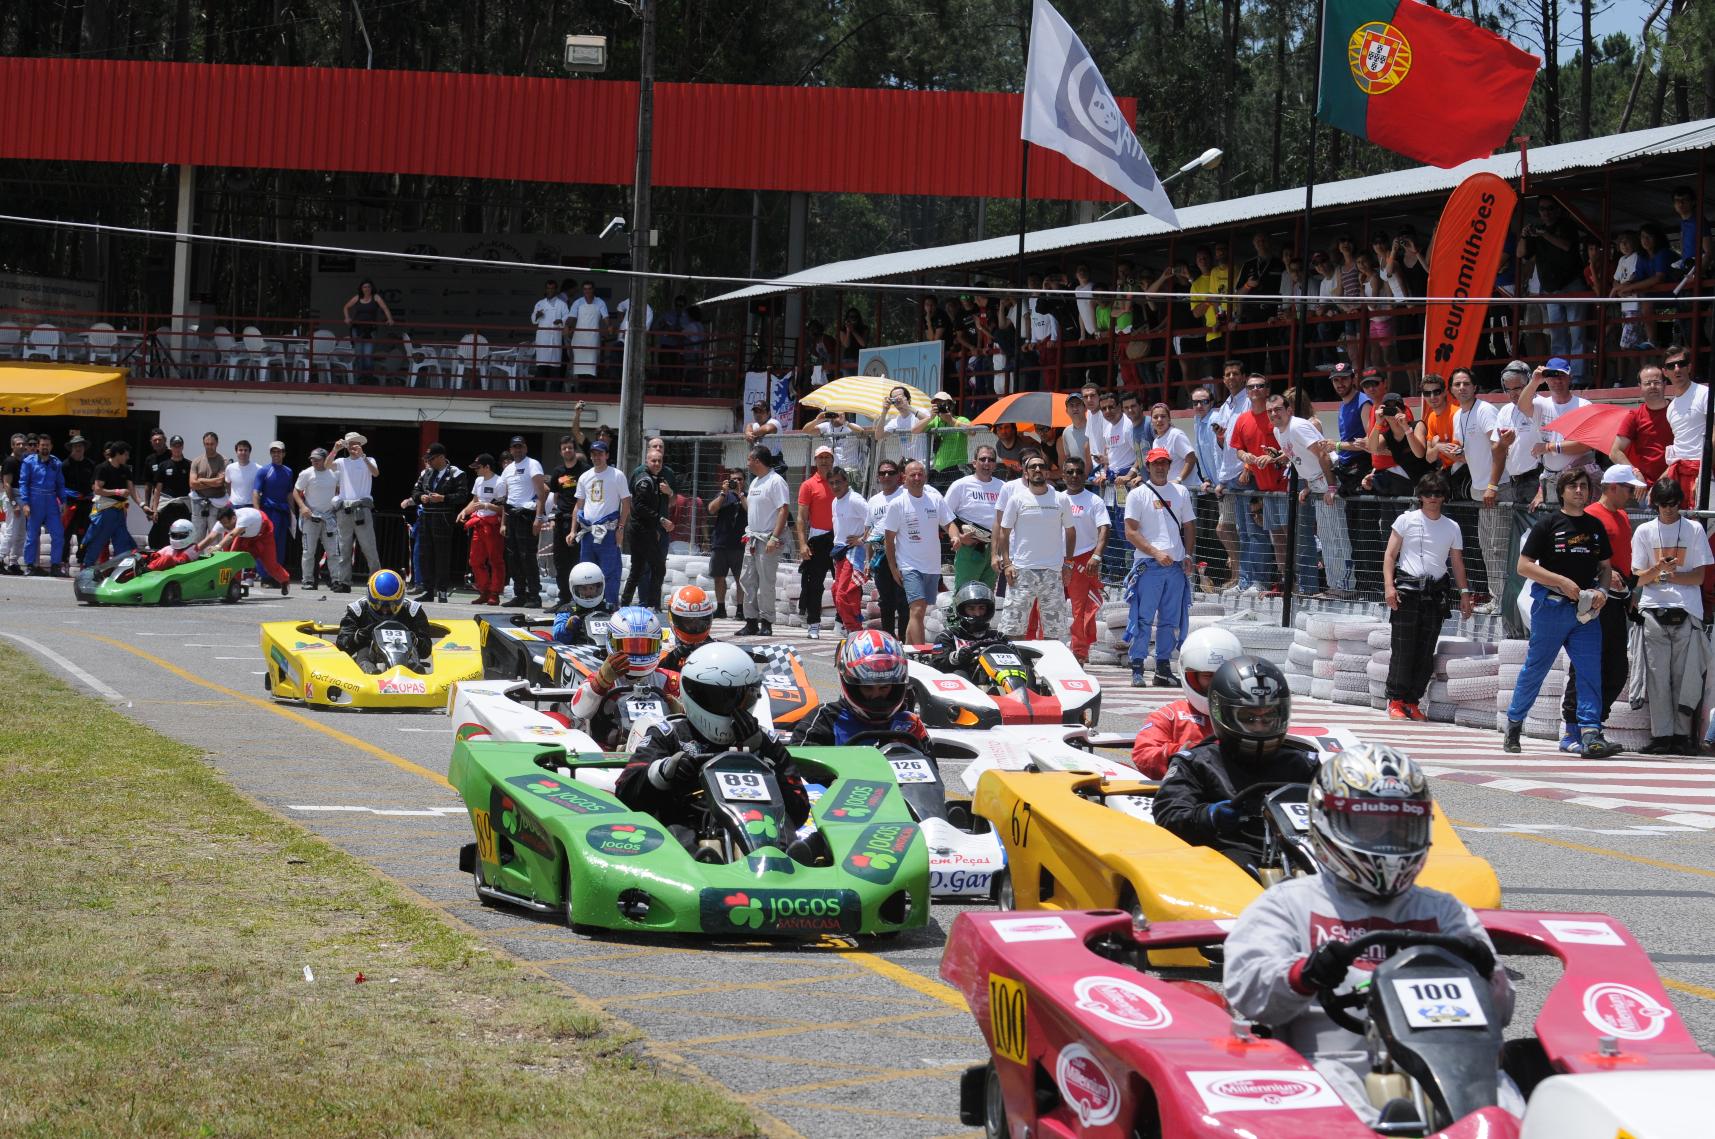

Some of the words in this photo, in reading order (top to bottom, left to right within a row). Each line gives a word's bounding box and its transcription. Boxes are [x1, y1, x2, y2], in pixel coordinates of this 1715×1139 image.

[1444, 192, 1496, 341] euromilhões
[972, 491, 999, 502] UNITRI
[1252, 688, 1271, 696] agv
[633, 702, 656, 710] 123
[892, 761, 921, 770] 126
[723, 774, 760, 787] 89
[548, 791, 607, 812] JOGOS
[843, 785, 873, 808] JOGOS
[1351, 802, 1399, 812] clube
[1402, 802, 1425, 816] bcp
[1011, 799, 1032, 848] 67
[476, 812, 492, 858] 89
[865, 825, 902, 854] JOGOS
[600, 840, 641, 851] JOGOS
[953, 854, 991, 867] Peças
[769, 897, 841, 923] JOGOS
[1409, 983, 1462, 1000] 100
[990, 981, 1026, 1060] 100
[1220, 1083, 1302, 1095] Millennium
